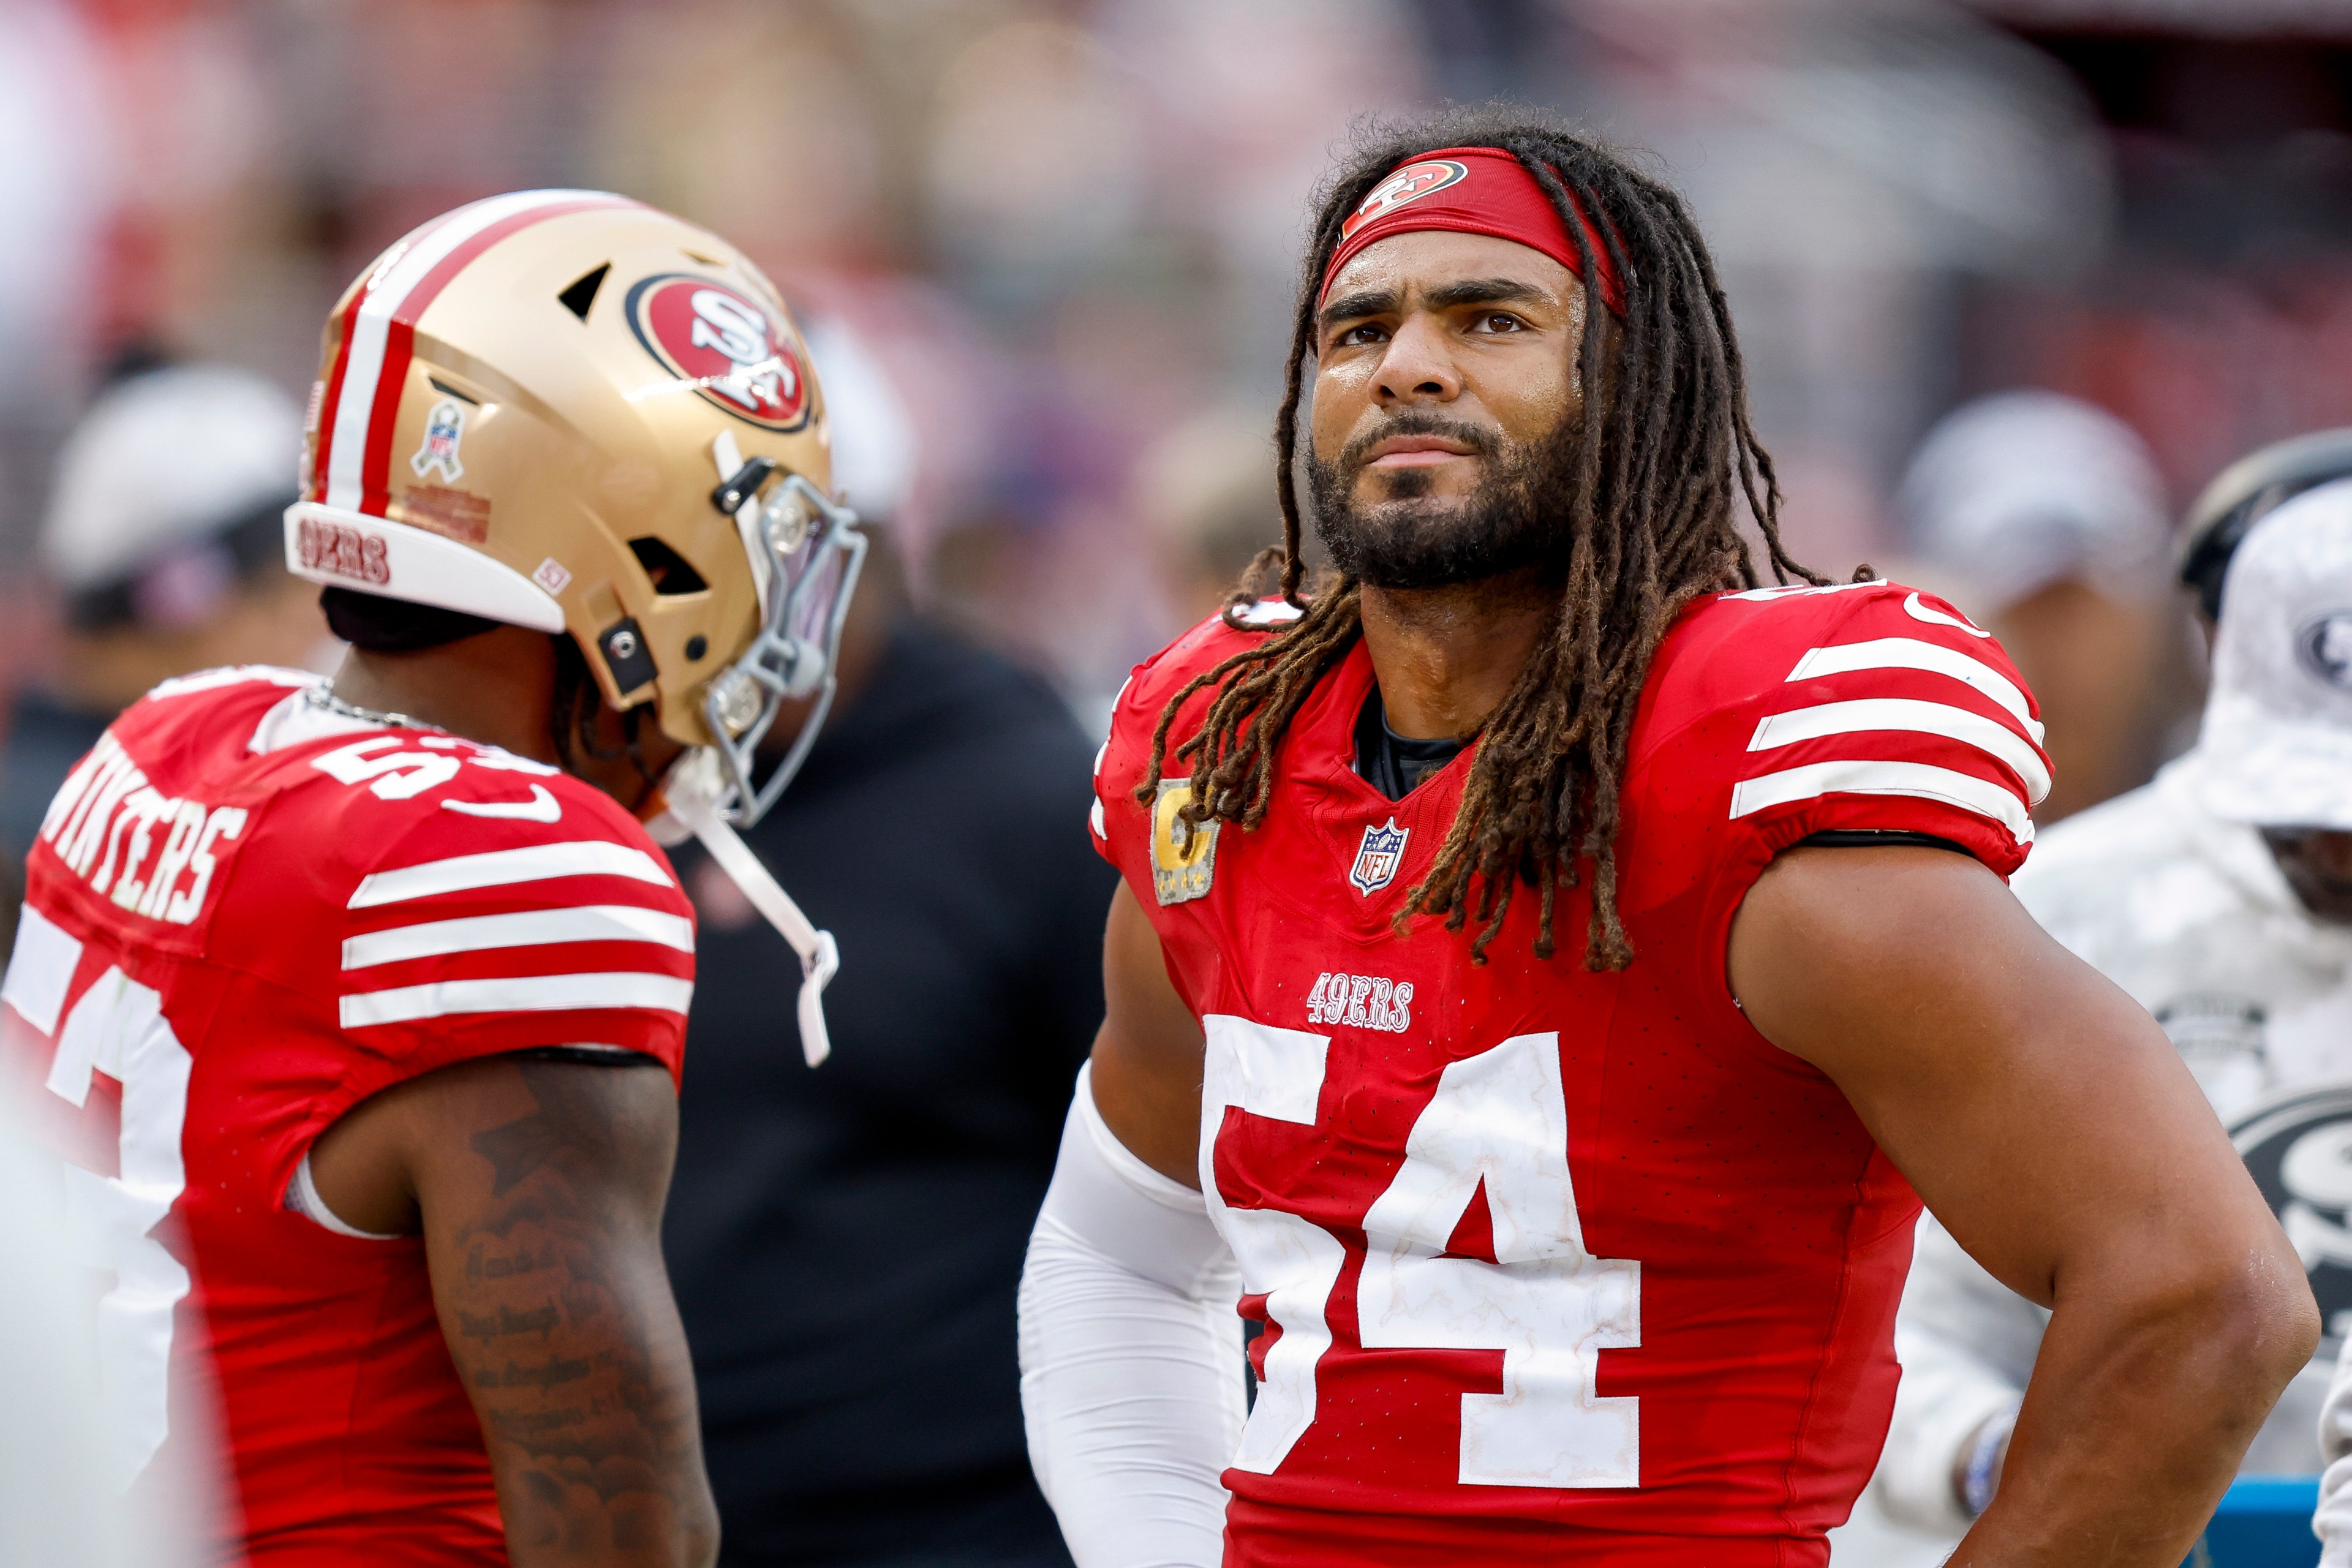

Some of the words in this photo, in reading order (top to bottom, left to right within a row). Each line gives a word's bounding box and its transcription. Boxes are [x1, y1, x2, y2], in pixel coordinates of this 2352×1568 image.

[1357, 854, 1390, 883] NFL
[1306, 972, 1414, 1034] 49ERS
[1198, 1014, 1642, 1488] 54
